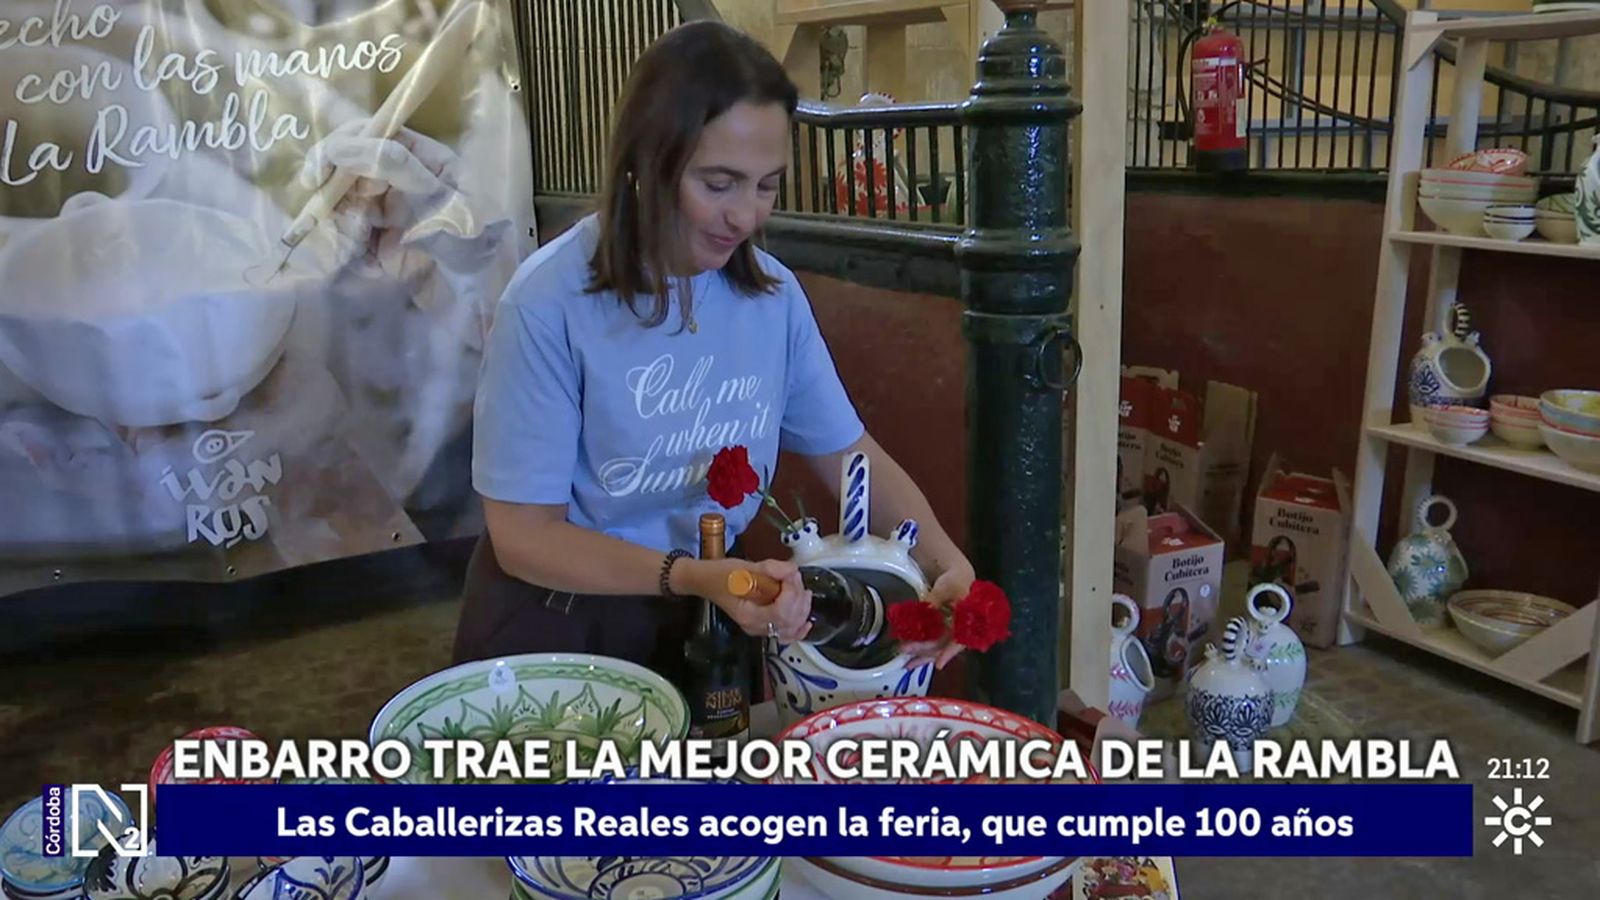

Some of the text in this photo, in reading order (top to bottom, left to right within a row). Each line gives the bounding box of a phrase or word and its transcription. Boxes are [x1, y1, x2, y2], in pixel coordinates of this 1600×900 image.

[15, 25, 407, 104] con las manos
[0, 92, 309, 185] La Rambla
[626, 353, 762, 419] Call me
[666, 397, 770, 457] when it
[1268, 516, 1320, 535] Cubitera
[1277, 507, 1314, 523] Botijo
[1164, 567, 1209, 582] Cubitera
[1172, 555, 1204, 569] Botijo
